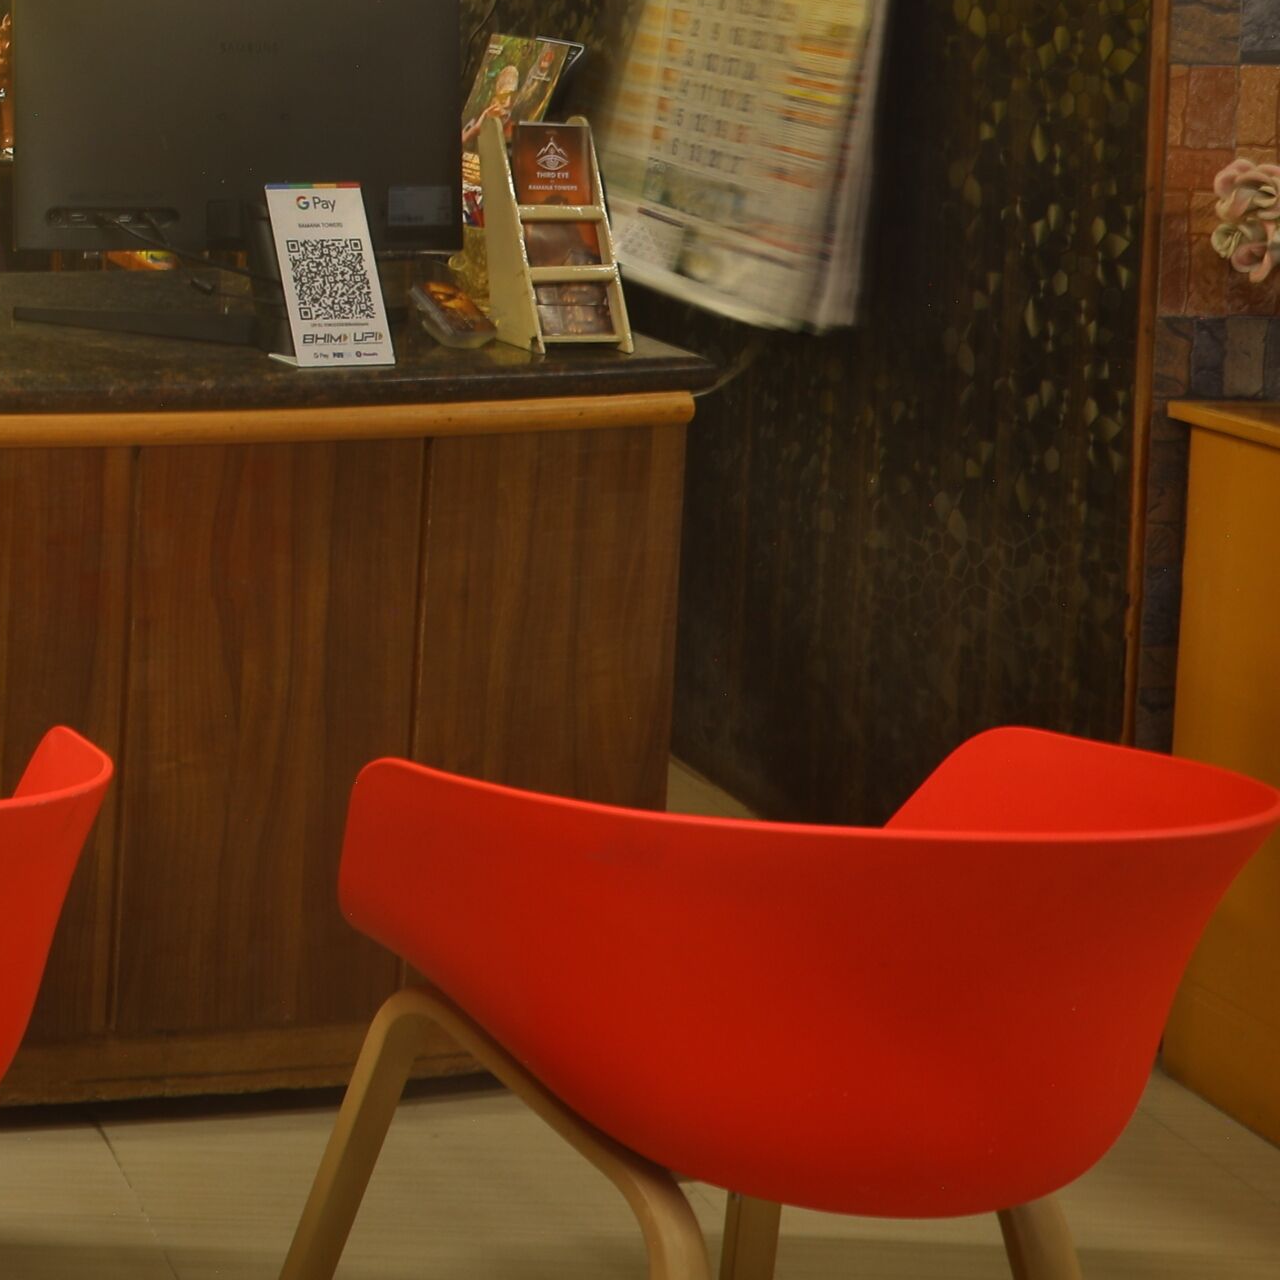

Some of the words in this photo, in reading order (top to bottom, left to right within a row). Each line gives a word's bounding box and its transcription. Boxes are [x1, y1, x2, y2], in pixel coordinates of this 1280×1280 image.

[296, 196, 310, 210] G
[312, 196, 336, 212] Pay
[302, 333, 342, 344] BHIM
[354, 332, 378, 342] UPI
